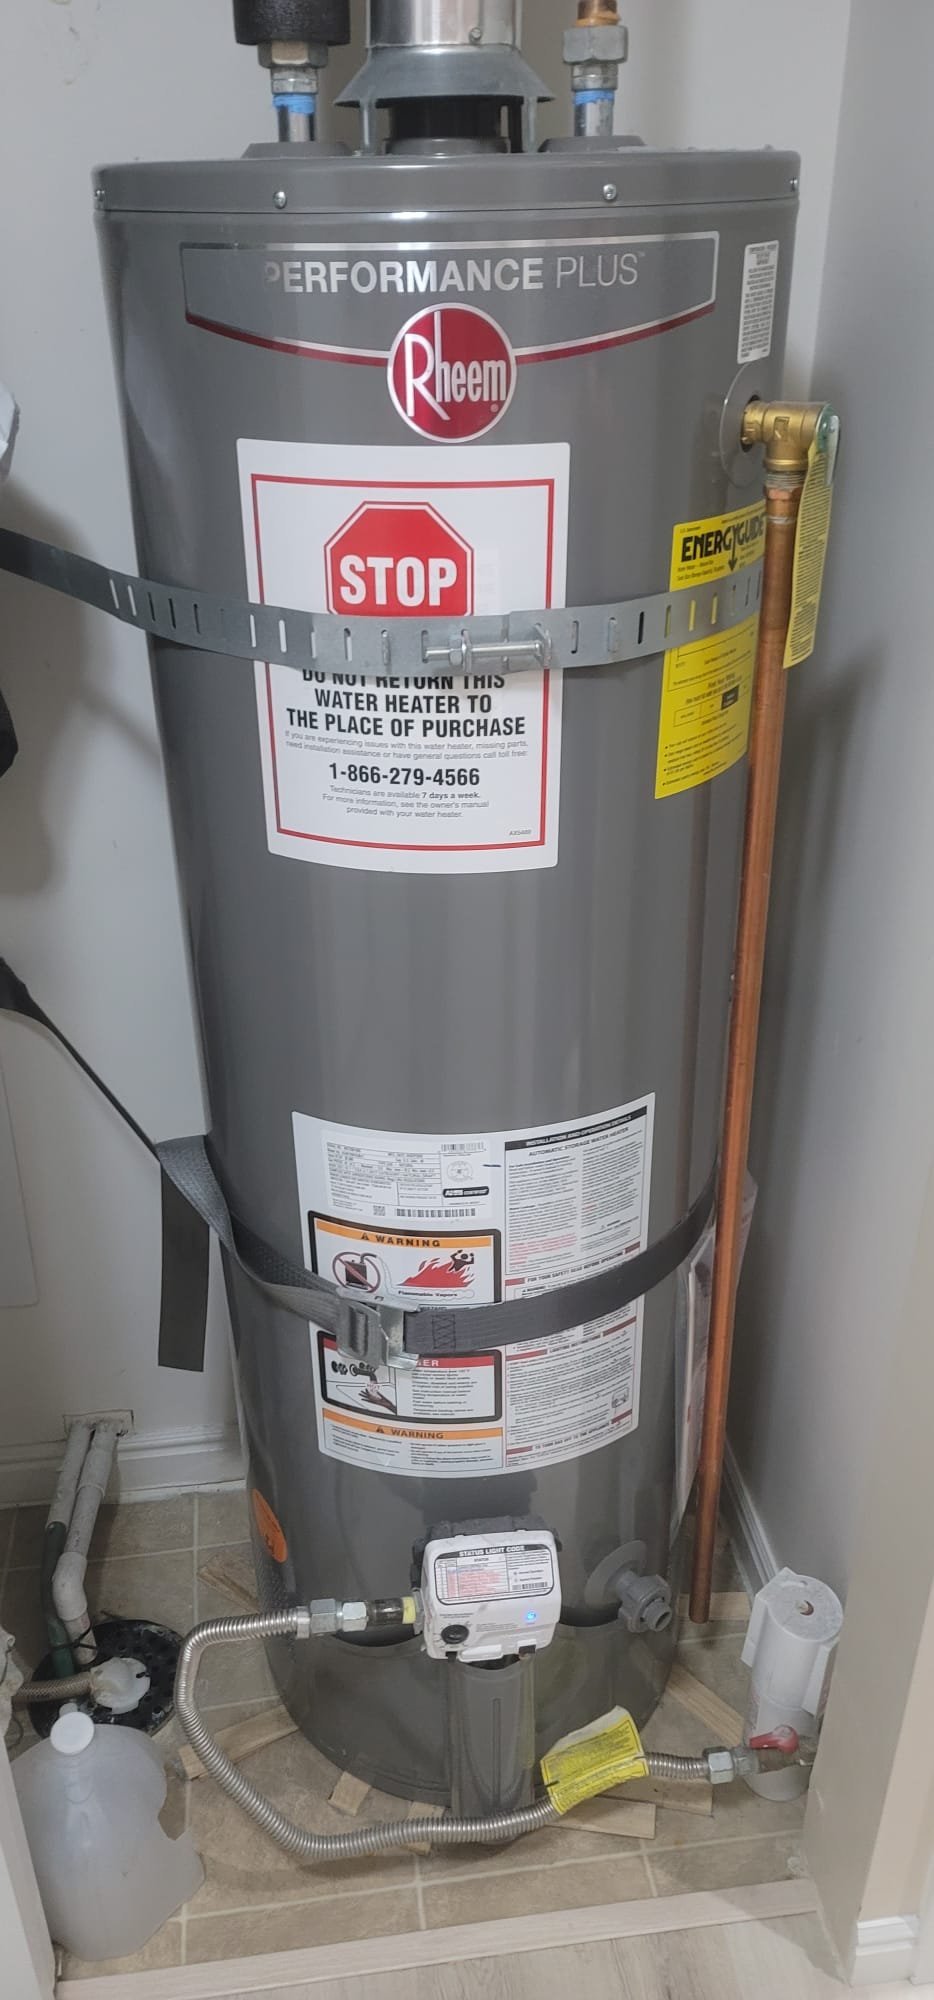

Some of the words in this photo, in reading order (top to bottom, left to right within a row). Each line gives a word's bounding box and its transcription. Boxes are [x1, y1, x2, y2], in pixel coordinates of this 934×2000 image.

[265, 258, 544, 293] PERFORMANCE
[404, 310, 507, 420] Rheem
[340, 554, 458, 607] STOP
[314, 688, 378, 712] WATER
[385, 694, 460, 714] HEATER
[467, 694, 492, 713] TO
[286, 708, 319, 730] THE
[325, 713, 384, 736] PLACE
[391, 718, 415, 737] OF
[422, 716, 526, 738] PURCHASE
[329, 762, 481, 786] 1-866-279-4566
[322, 793, 333, 802] For
[335, 796, 354, 804] more
[416, 800, 429, 808] the
[430, 800, 460, 809] owner's
[461, 800, 490, 809] manual
[329, 784, 371, 797] Technicians
[387, 791, 421, 799] available
[422, 791, 427, 799] 7
[429, 791, 449, 800] days
[458, 791, 480, 799] week.
[346, 806, 378, 817] provided
[379, 808, 395, 816] with
[396, 810, 413, 818] your
[414, 810, 435, 818] water
[376, 1234, 441, 1247] WARNING
[392, 1427, 444, 1440] WARNING
[459, 1549, 484, 1557] STATUS
